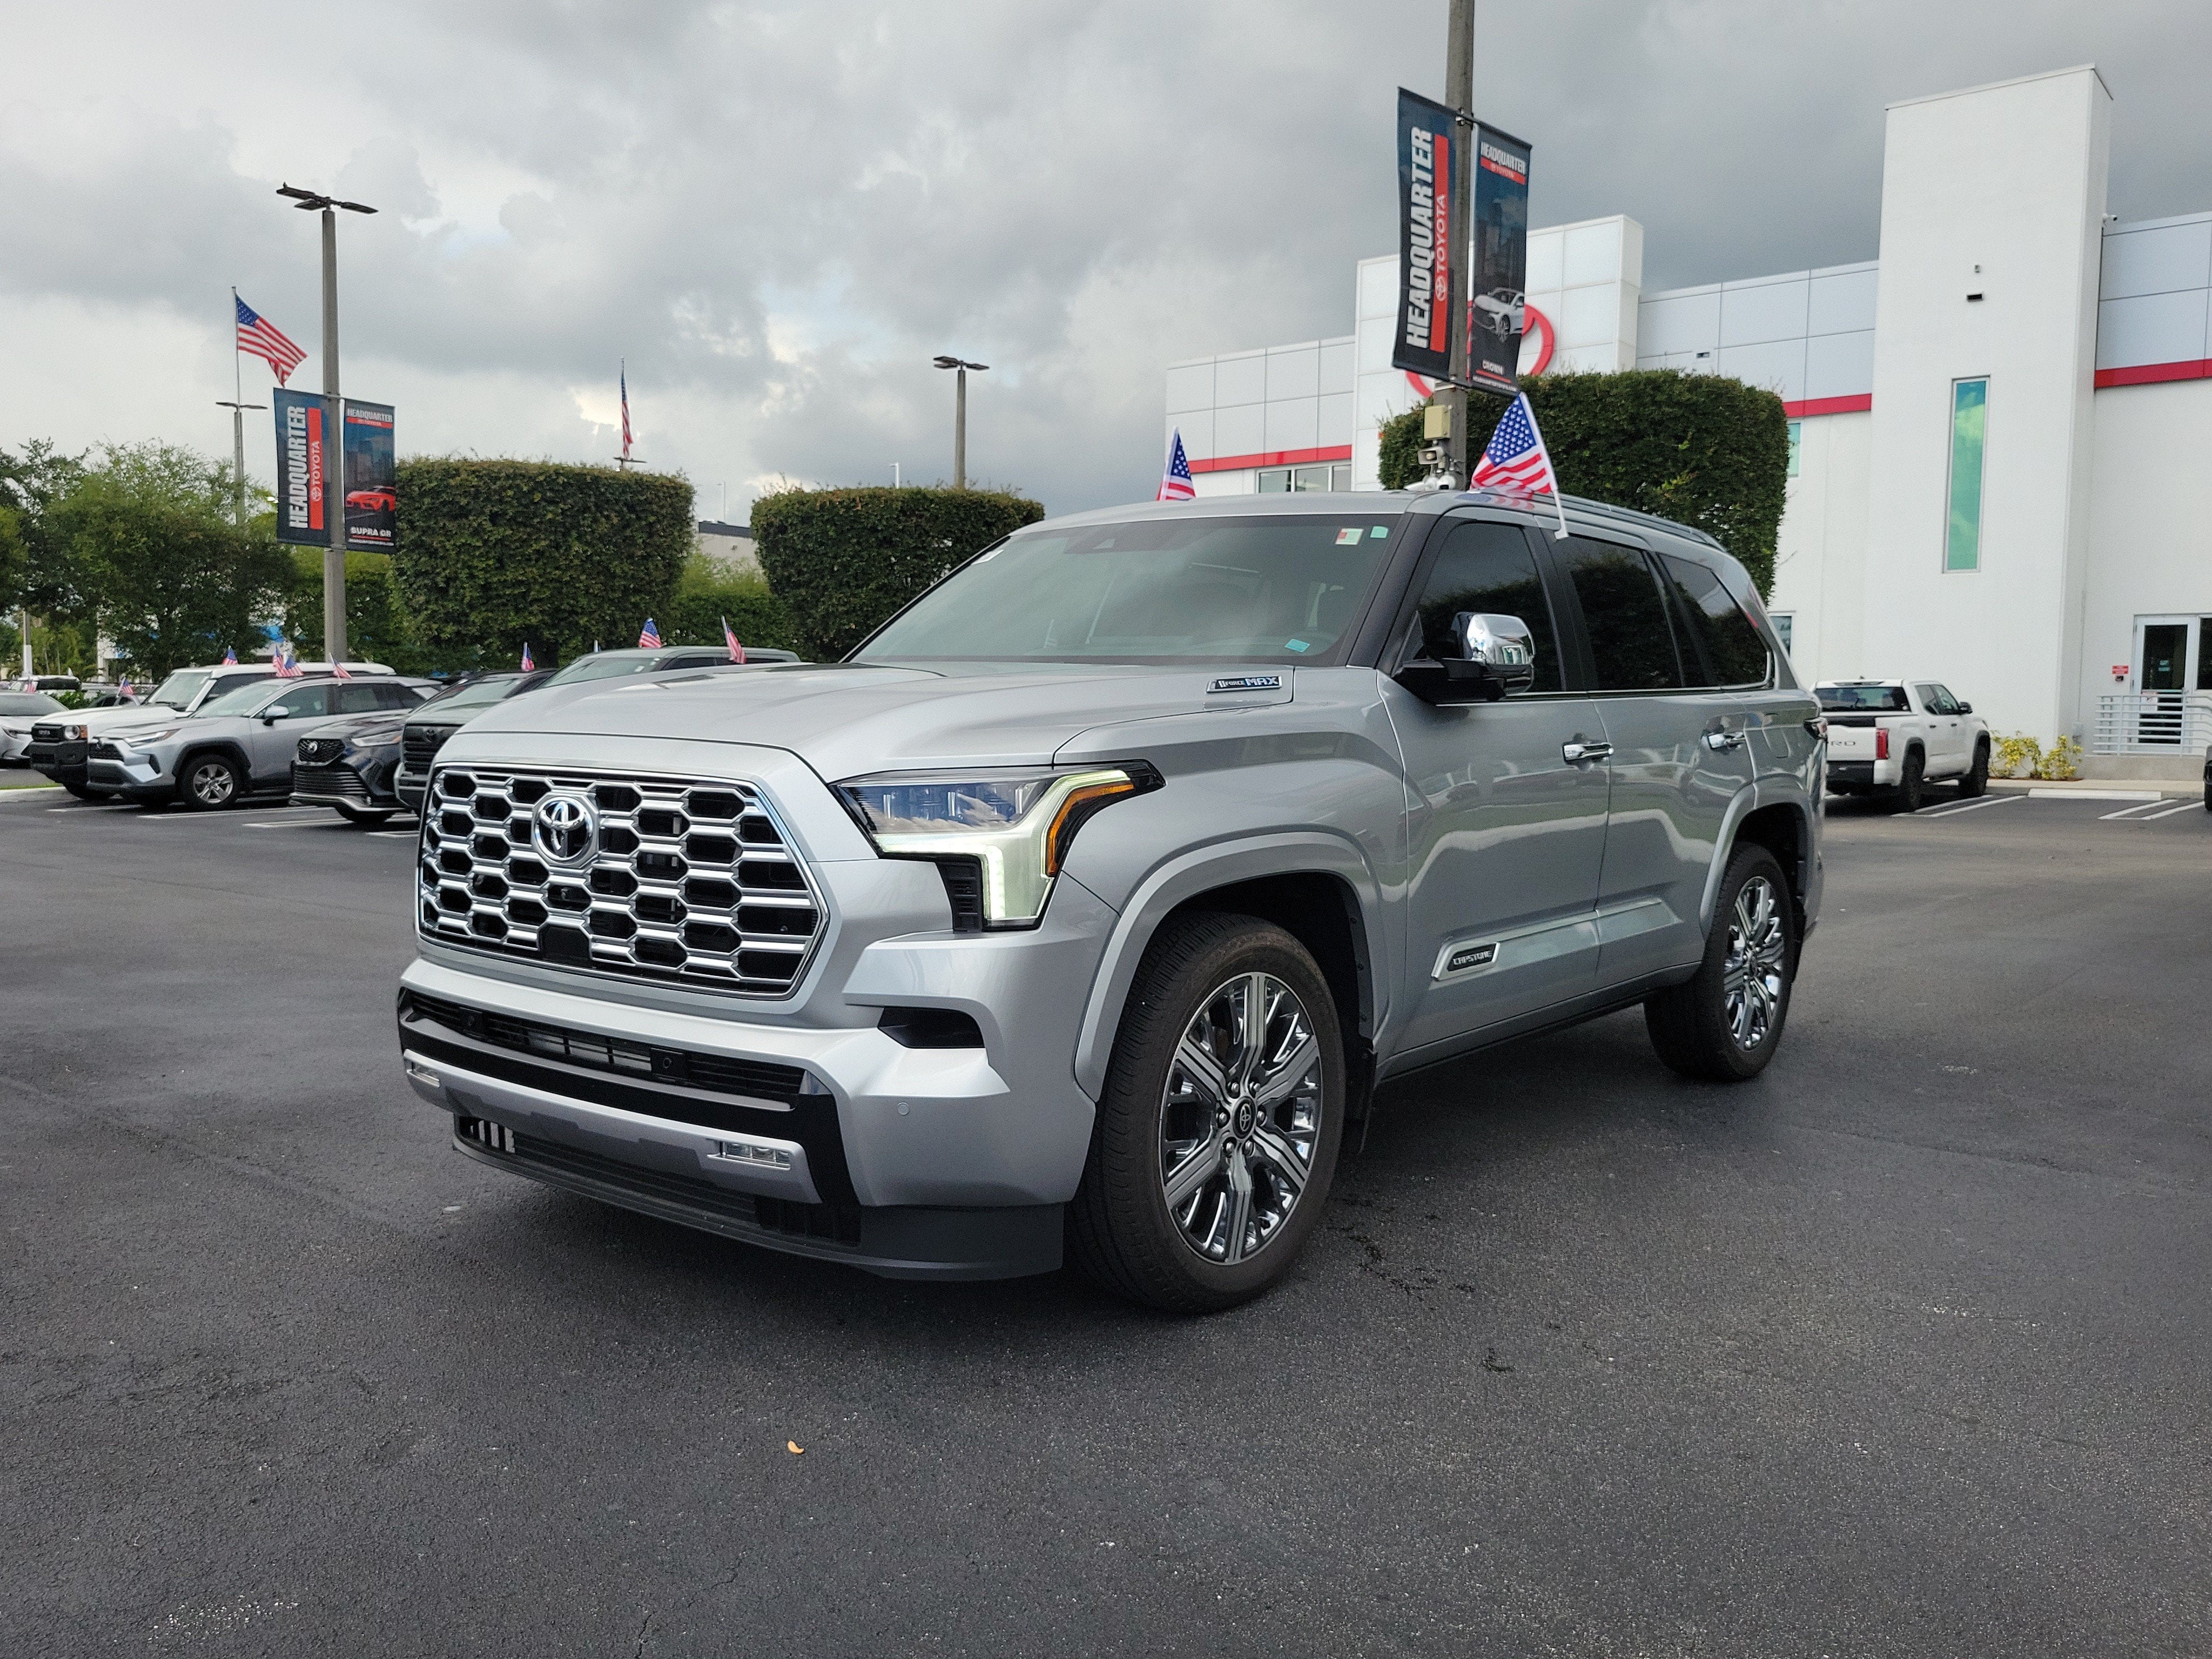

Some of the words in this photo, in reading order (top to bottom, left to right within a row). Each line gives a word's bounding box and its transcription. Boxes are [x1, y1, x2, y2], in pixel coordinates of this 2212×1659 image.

[1481, 142, 1526, 175] HEADQUARTER
[1406, 126, 1434, 349] HEADQUARTER
[1436, 194, 1447, 273] TOYOTA
[347, 408, 393, 422] HEADQUARTER
[287, 406, 309, 529] HEADQUARTER
[311, 441, 320, 486] TOYOTA
[350, 527, 379, 537] SUPRA
[379, 529, 392, 538] GR
[1245, 677, 1279, 686] MAX
[1453, 950, 1492, 966] CAPSTONE
